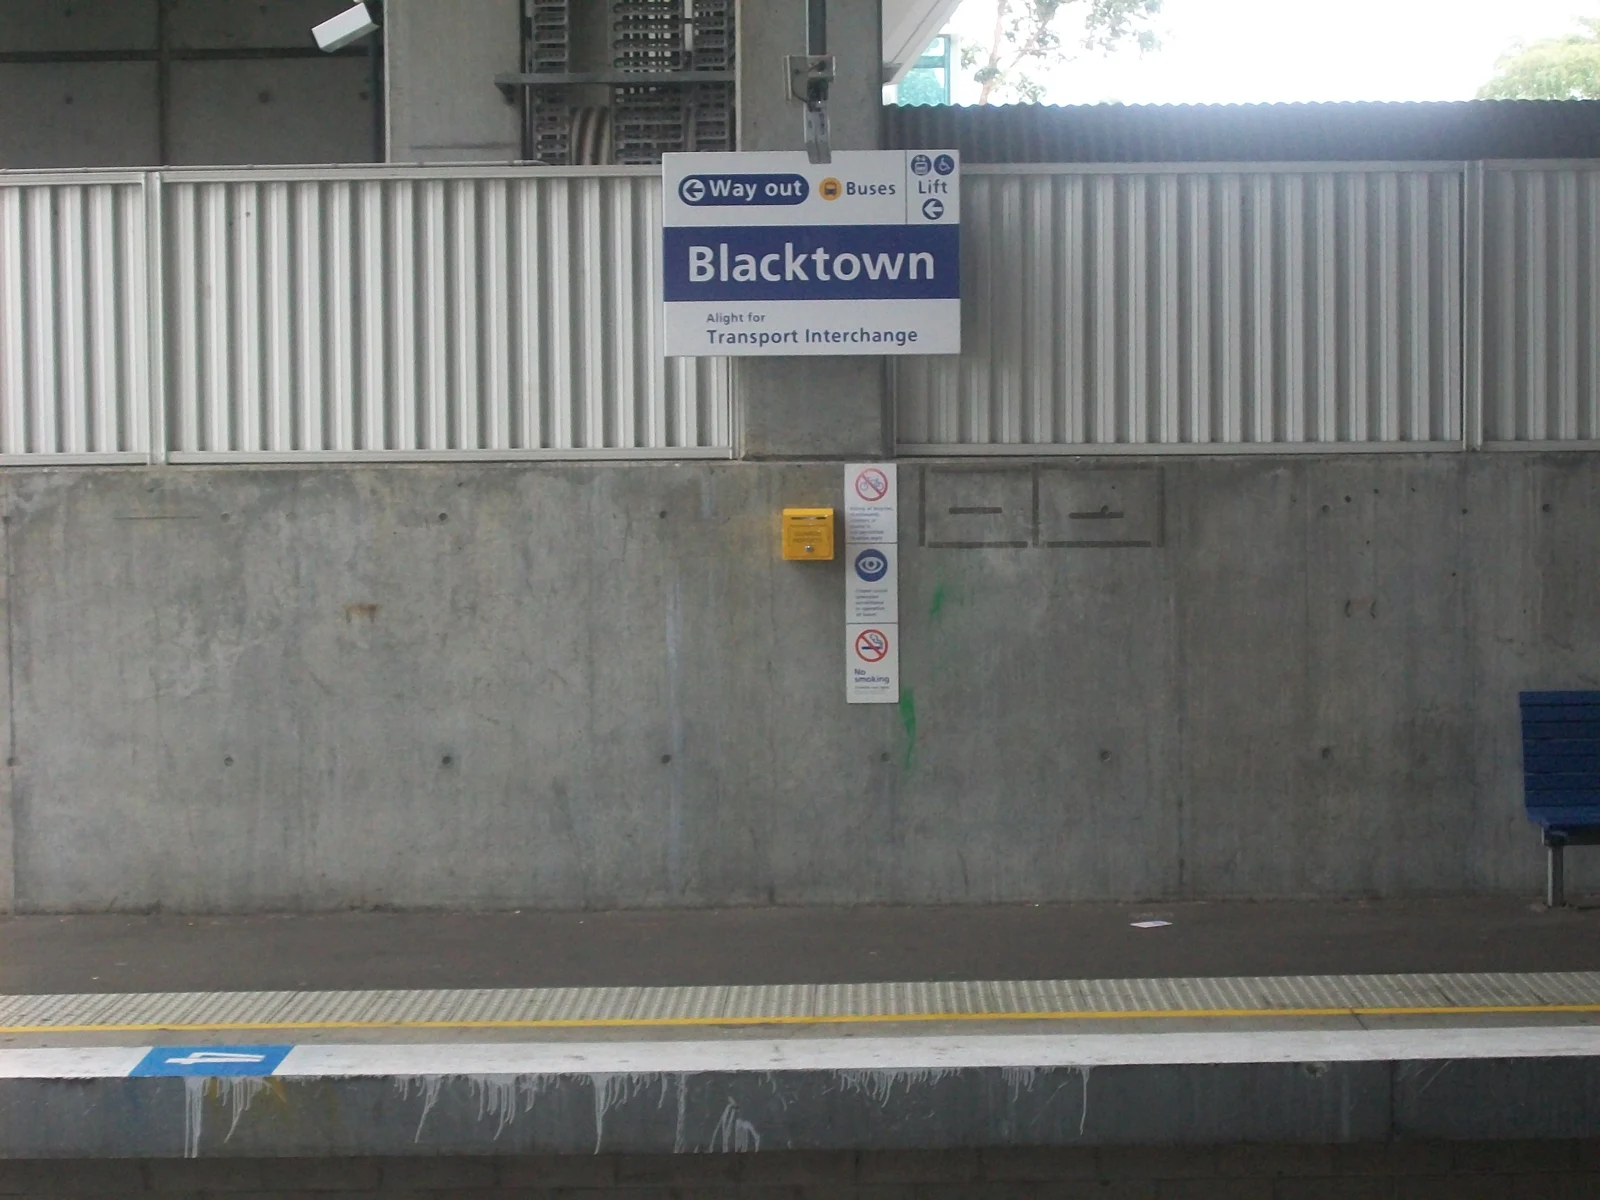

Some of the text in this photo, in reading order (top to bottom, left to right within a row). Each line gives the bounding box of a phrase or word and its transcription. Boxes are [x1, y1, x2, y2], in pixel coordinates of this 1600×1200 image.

[709, 179, 803, 202] Way out
[846, 181, 896, 196] Buses
[918, 179, 948, 195] Lift
[688, 242, 935, 283] Blacktown
[706, 312, 766, 325] Alight for
[707, 328, 918, 347] Transport Interchange
[854, 675, 890, 684] smoking
